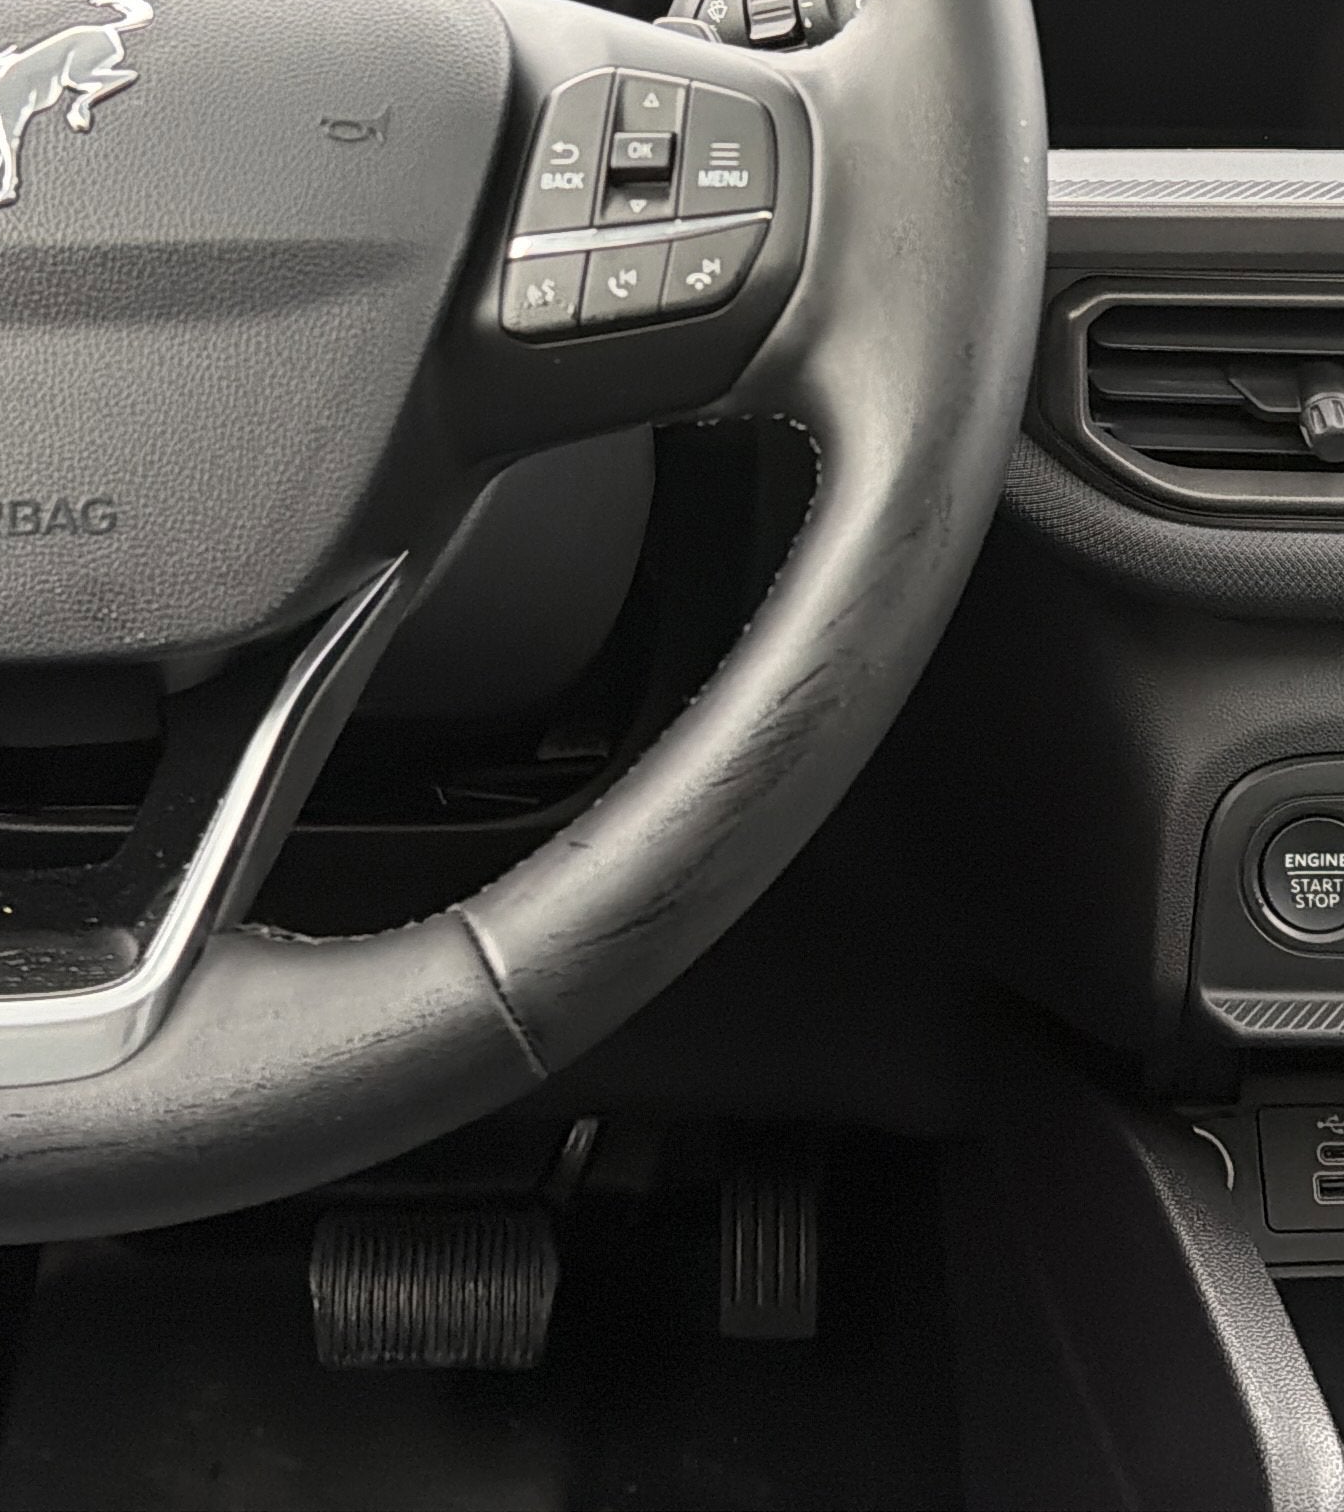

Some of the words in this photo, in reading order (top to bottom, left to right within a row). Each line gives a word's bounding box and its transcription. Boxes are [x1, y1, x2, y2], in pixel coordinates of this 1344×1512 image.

[627, 141, 654, 159] OK
[540, 173, 585, 190] BACK
[697, 170, 749, 188] MENU
[1290, 878, 1344, 893] START
[1295, 893, 1340, 909] STOP
